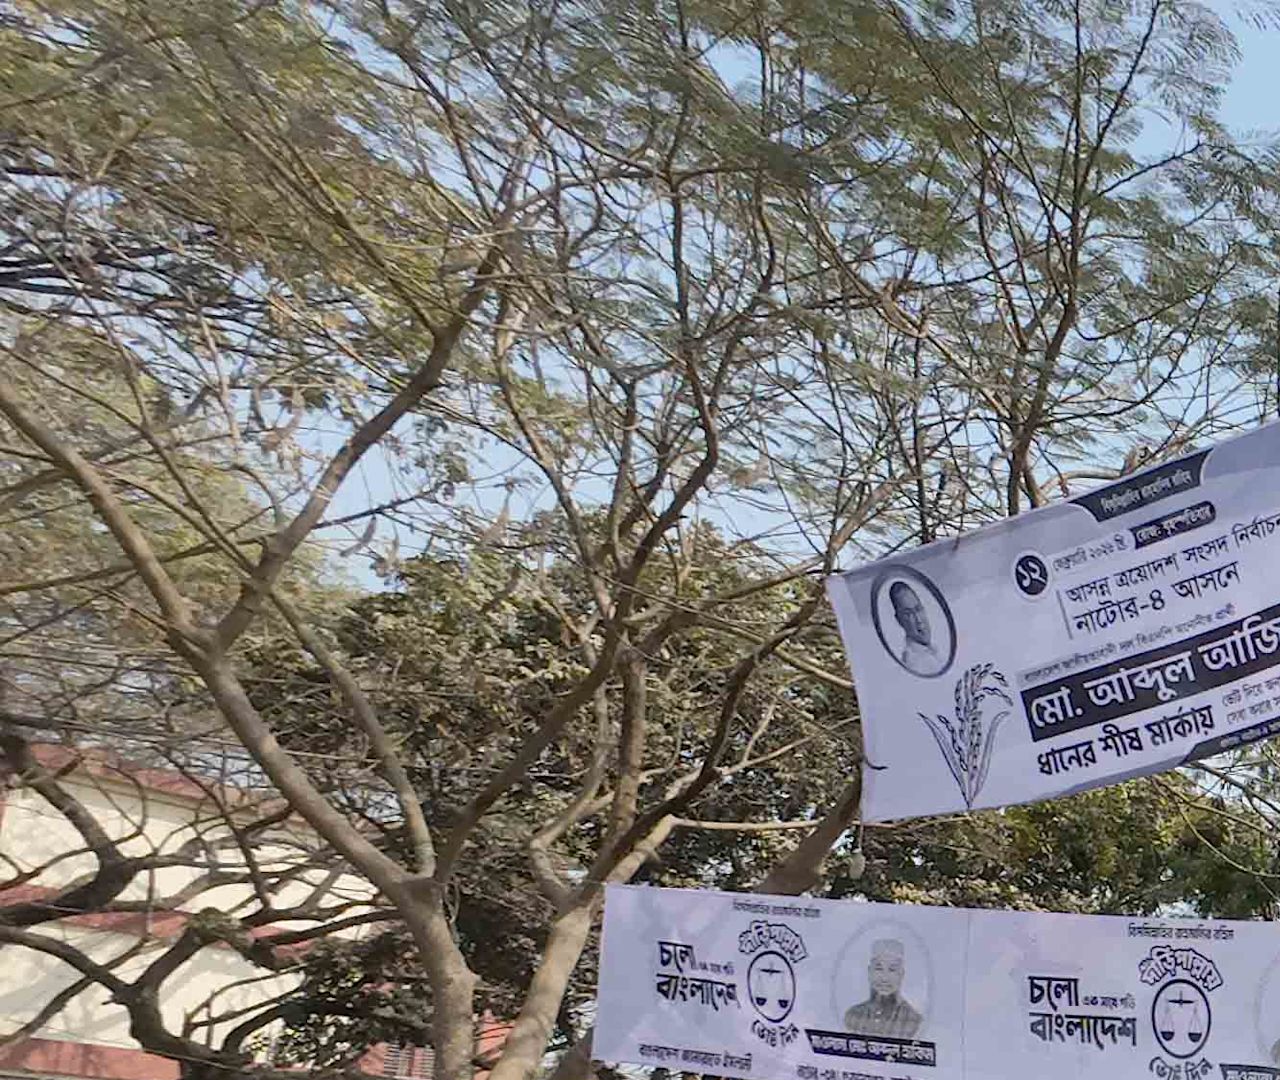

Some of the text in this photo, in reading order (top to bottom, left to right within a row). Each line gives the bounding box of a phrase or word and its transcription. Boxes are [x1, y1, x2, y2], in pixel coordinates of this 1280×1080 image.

[1016, 560, 1047, 589] ১২
[1066, 577, 1110, 603] আসন্ন
[1114, 553, 1180, 588] ত্রয়োদশ
[1183, 535, 1229, 563] সংসদ
[1073, 560, 1241, 634] নাটোর-৪ আসনে
[1031, 688, 1083, 729] মো.
[1084, 649, 1197, 706] আব্দুল
[1037, 741, 1097, 777] ধানের
[1098, 718, 1142, 759] শীষ
[1146, 703, 1216, 747] মার্কায়
[658, 940, 698, 974] চলো
[655, 972, 742, 1011] বাংলাদেশ
[1028, 976, 1079, 1011] চলো
[1028, 1011, 1137, 1051] বাংলাদেশ
